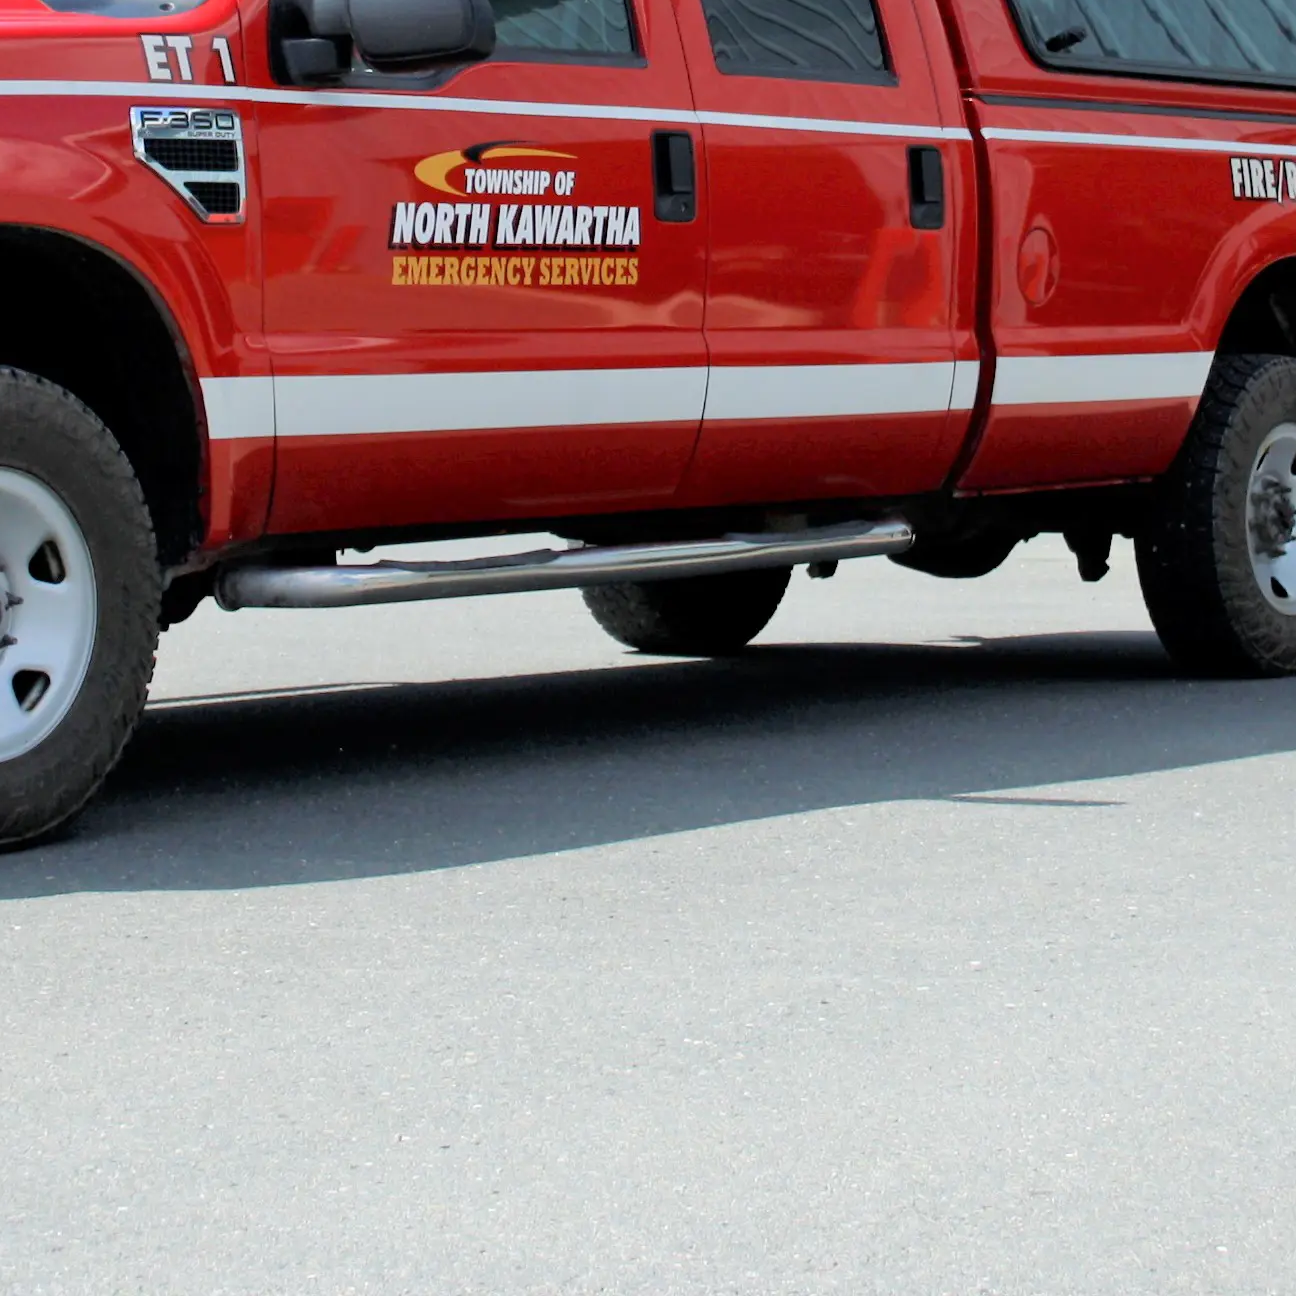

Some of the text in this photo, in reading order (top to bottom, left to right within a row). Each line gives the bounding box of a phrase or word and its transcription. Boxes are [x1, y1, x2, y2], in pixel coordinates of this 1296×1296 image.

[139, 34, 236, 83] ET 1
[140, 110, 235, 130] F-350
[215, 131, 236, 139] DUTY
[464, 168, 576, 196] TOWNSHIP OF
[390, 202, 641, 248] NORTH KAWARTHA
[392, 256, 640, 286] EMERGENCY SERVICES
